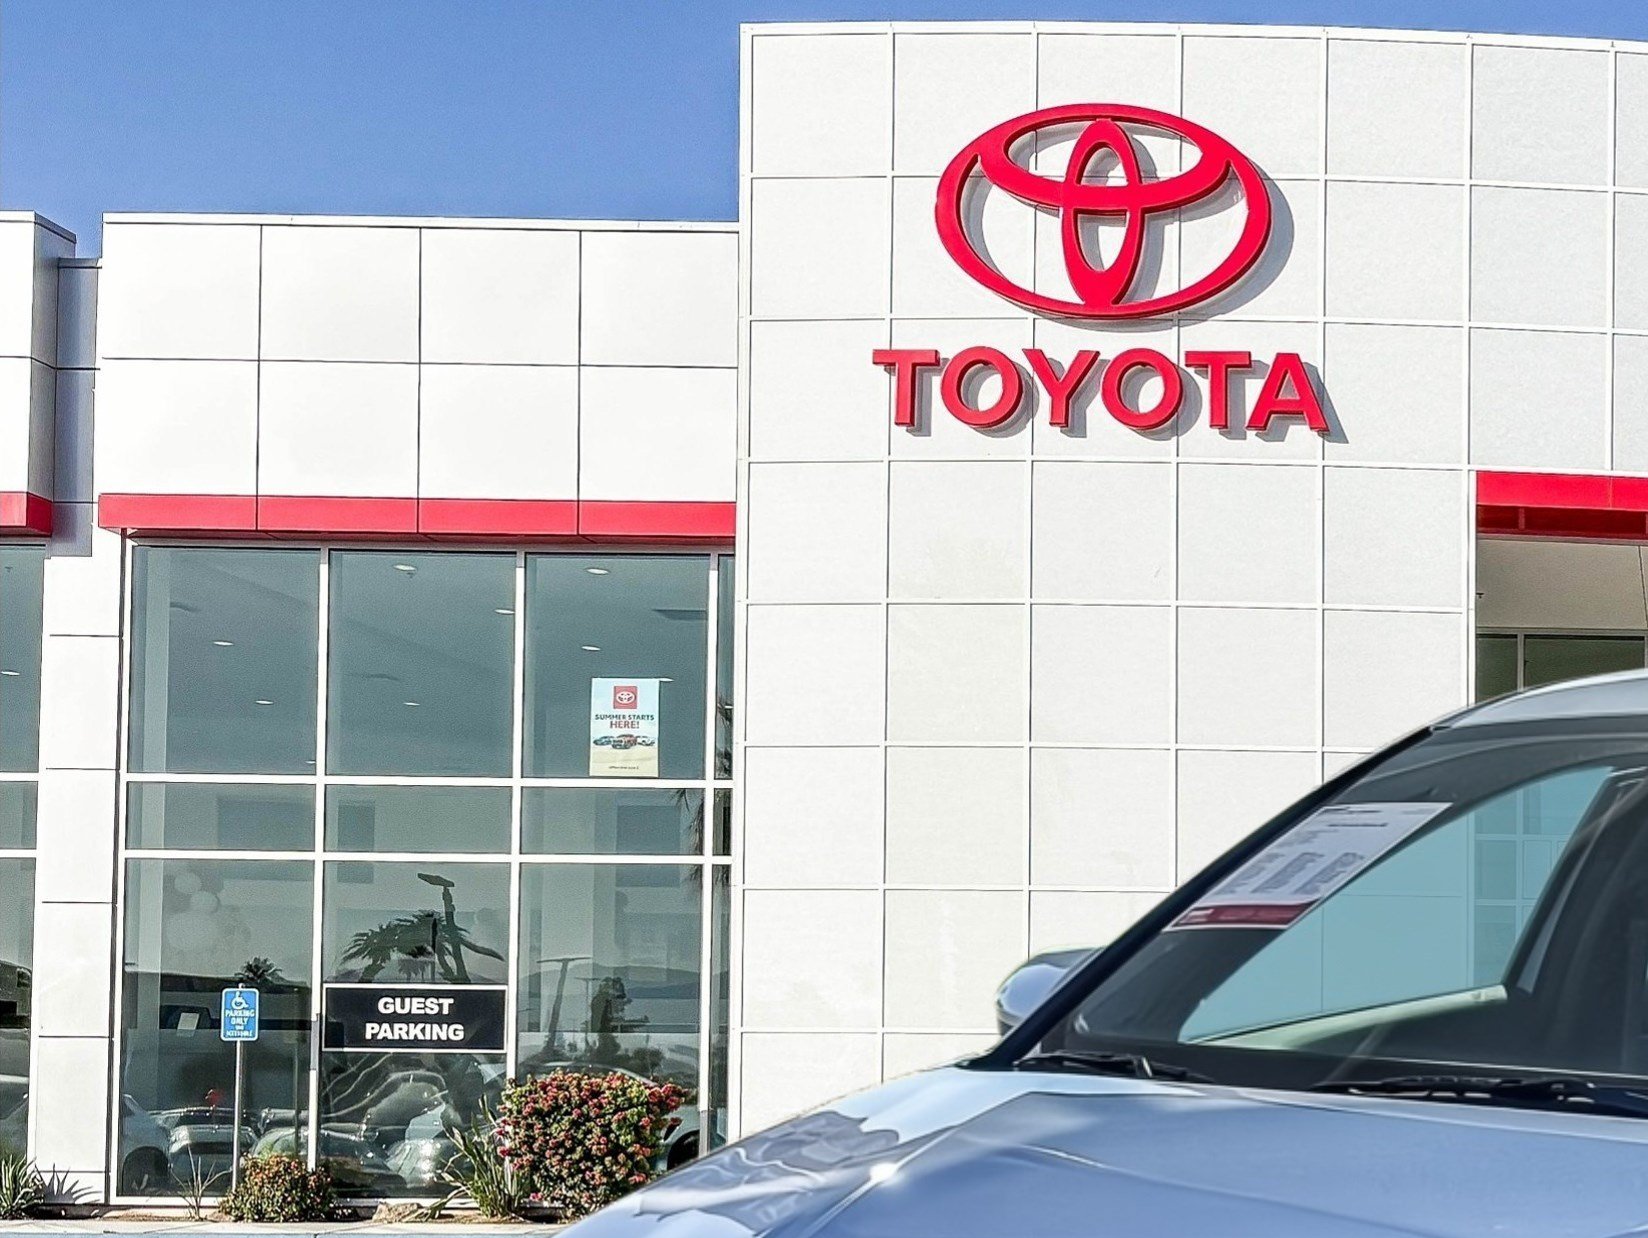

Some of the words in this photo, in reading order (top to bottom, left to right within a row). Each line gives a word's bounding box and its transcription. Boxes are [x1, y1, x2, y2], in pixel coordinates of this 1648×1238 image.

[872, 346, 1329, 432] TOYOTA
[609, 720, 640, 729] HERE!
[377, 997, 454, 1015] GUEST
[364, 1022, 465, 1041] PARKING
